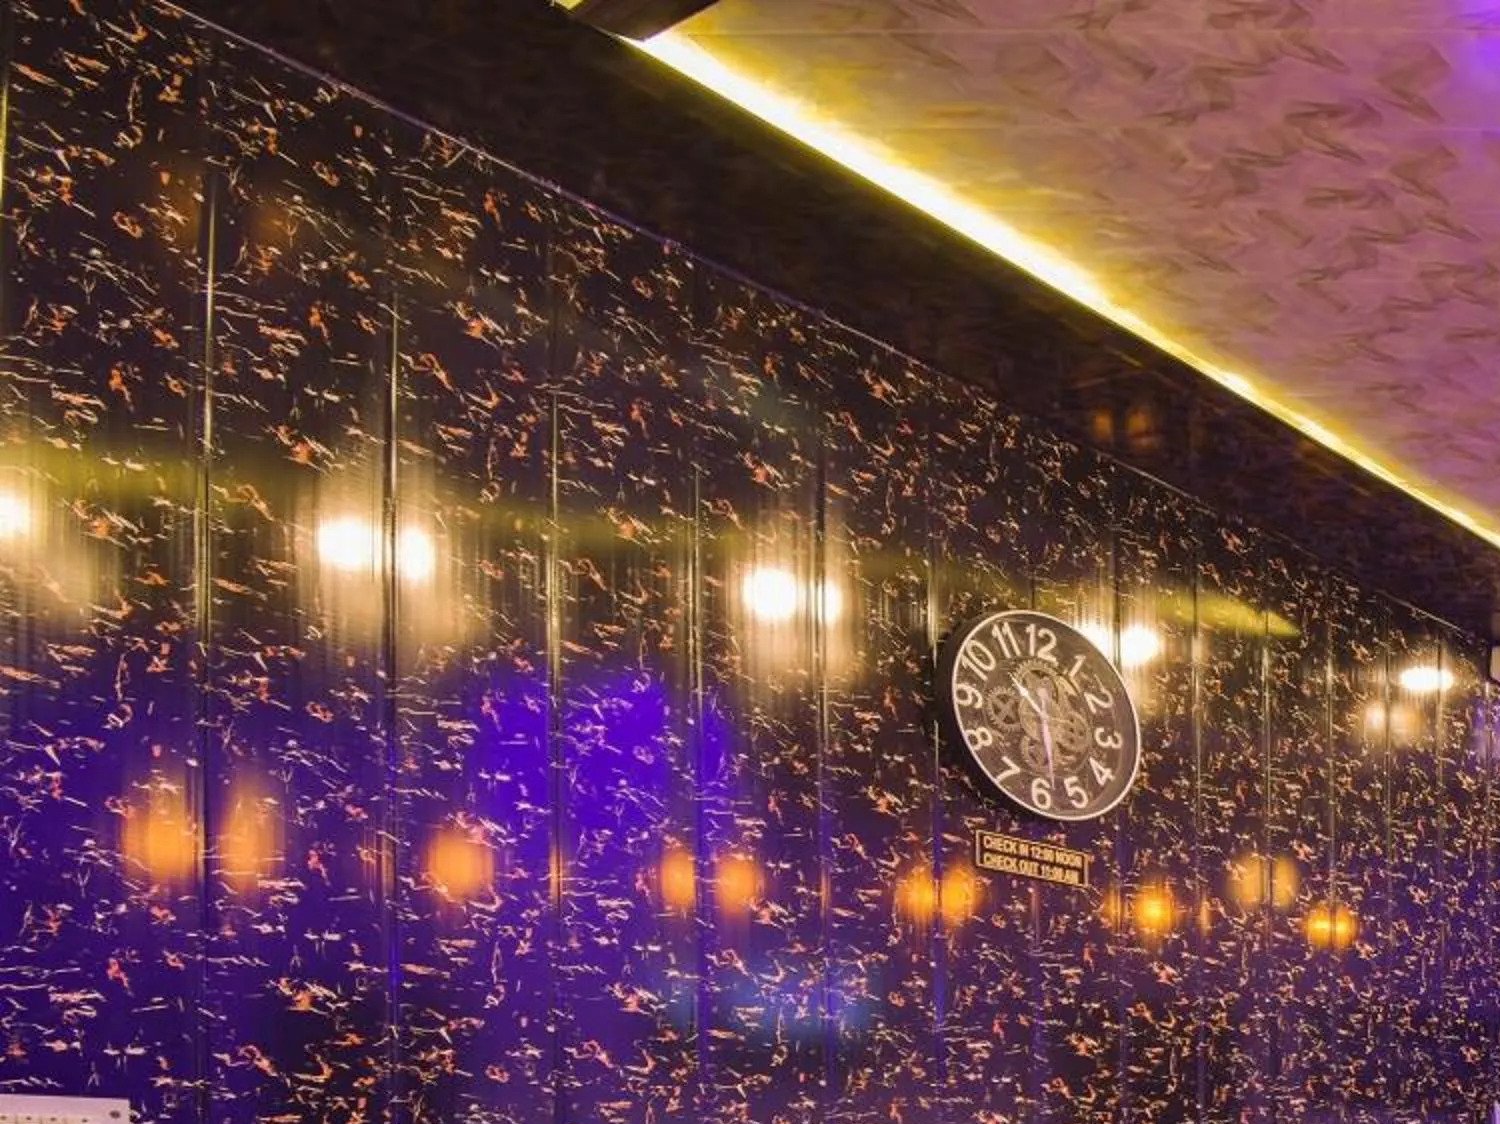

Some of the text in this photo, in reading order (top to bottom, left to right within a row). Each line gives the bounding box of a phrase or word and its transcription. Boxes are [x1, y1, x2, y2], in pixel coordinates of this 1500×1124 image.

[991, 621, 1021, 659] 11
[1025, 624, 1059, 664] 12
[962, 639, 996, 680] 10
[1094, 727, 1123, 750] 3
[994, 756, 1021, 784] 7
[1089, 757, 1115, 786] 4
[1031, 777, 1052, 809] 6
[1063, 775, 1089, 808] 5
[983, 835, 1018, 855] CHECK
[983, 852, 1018, 872] CHECK
[1019, 859, 1040, 876] OUT
